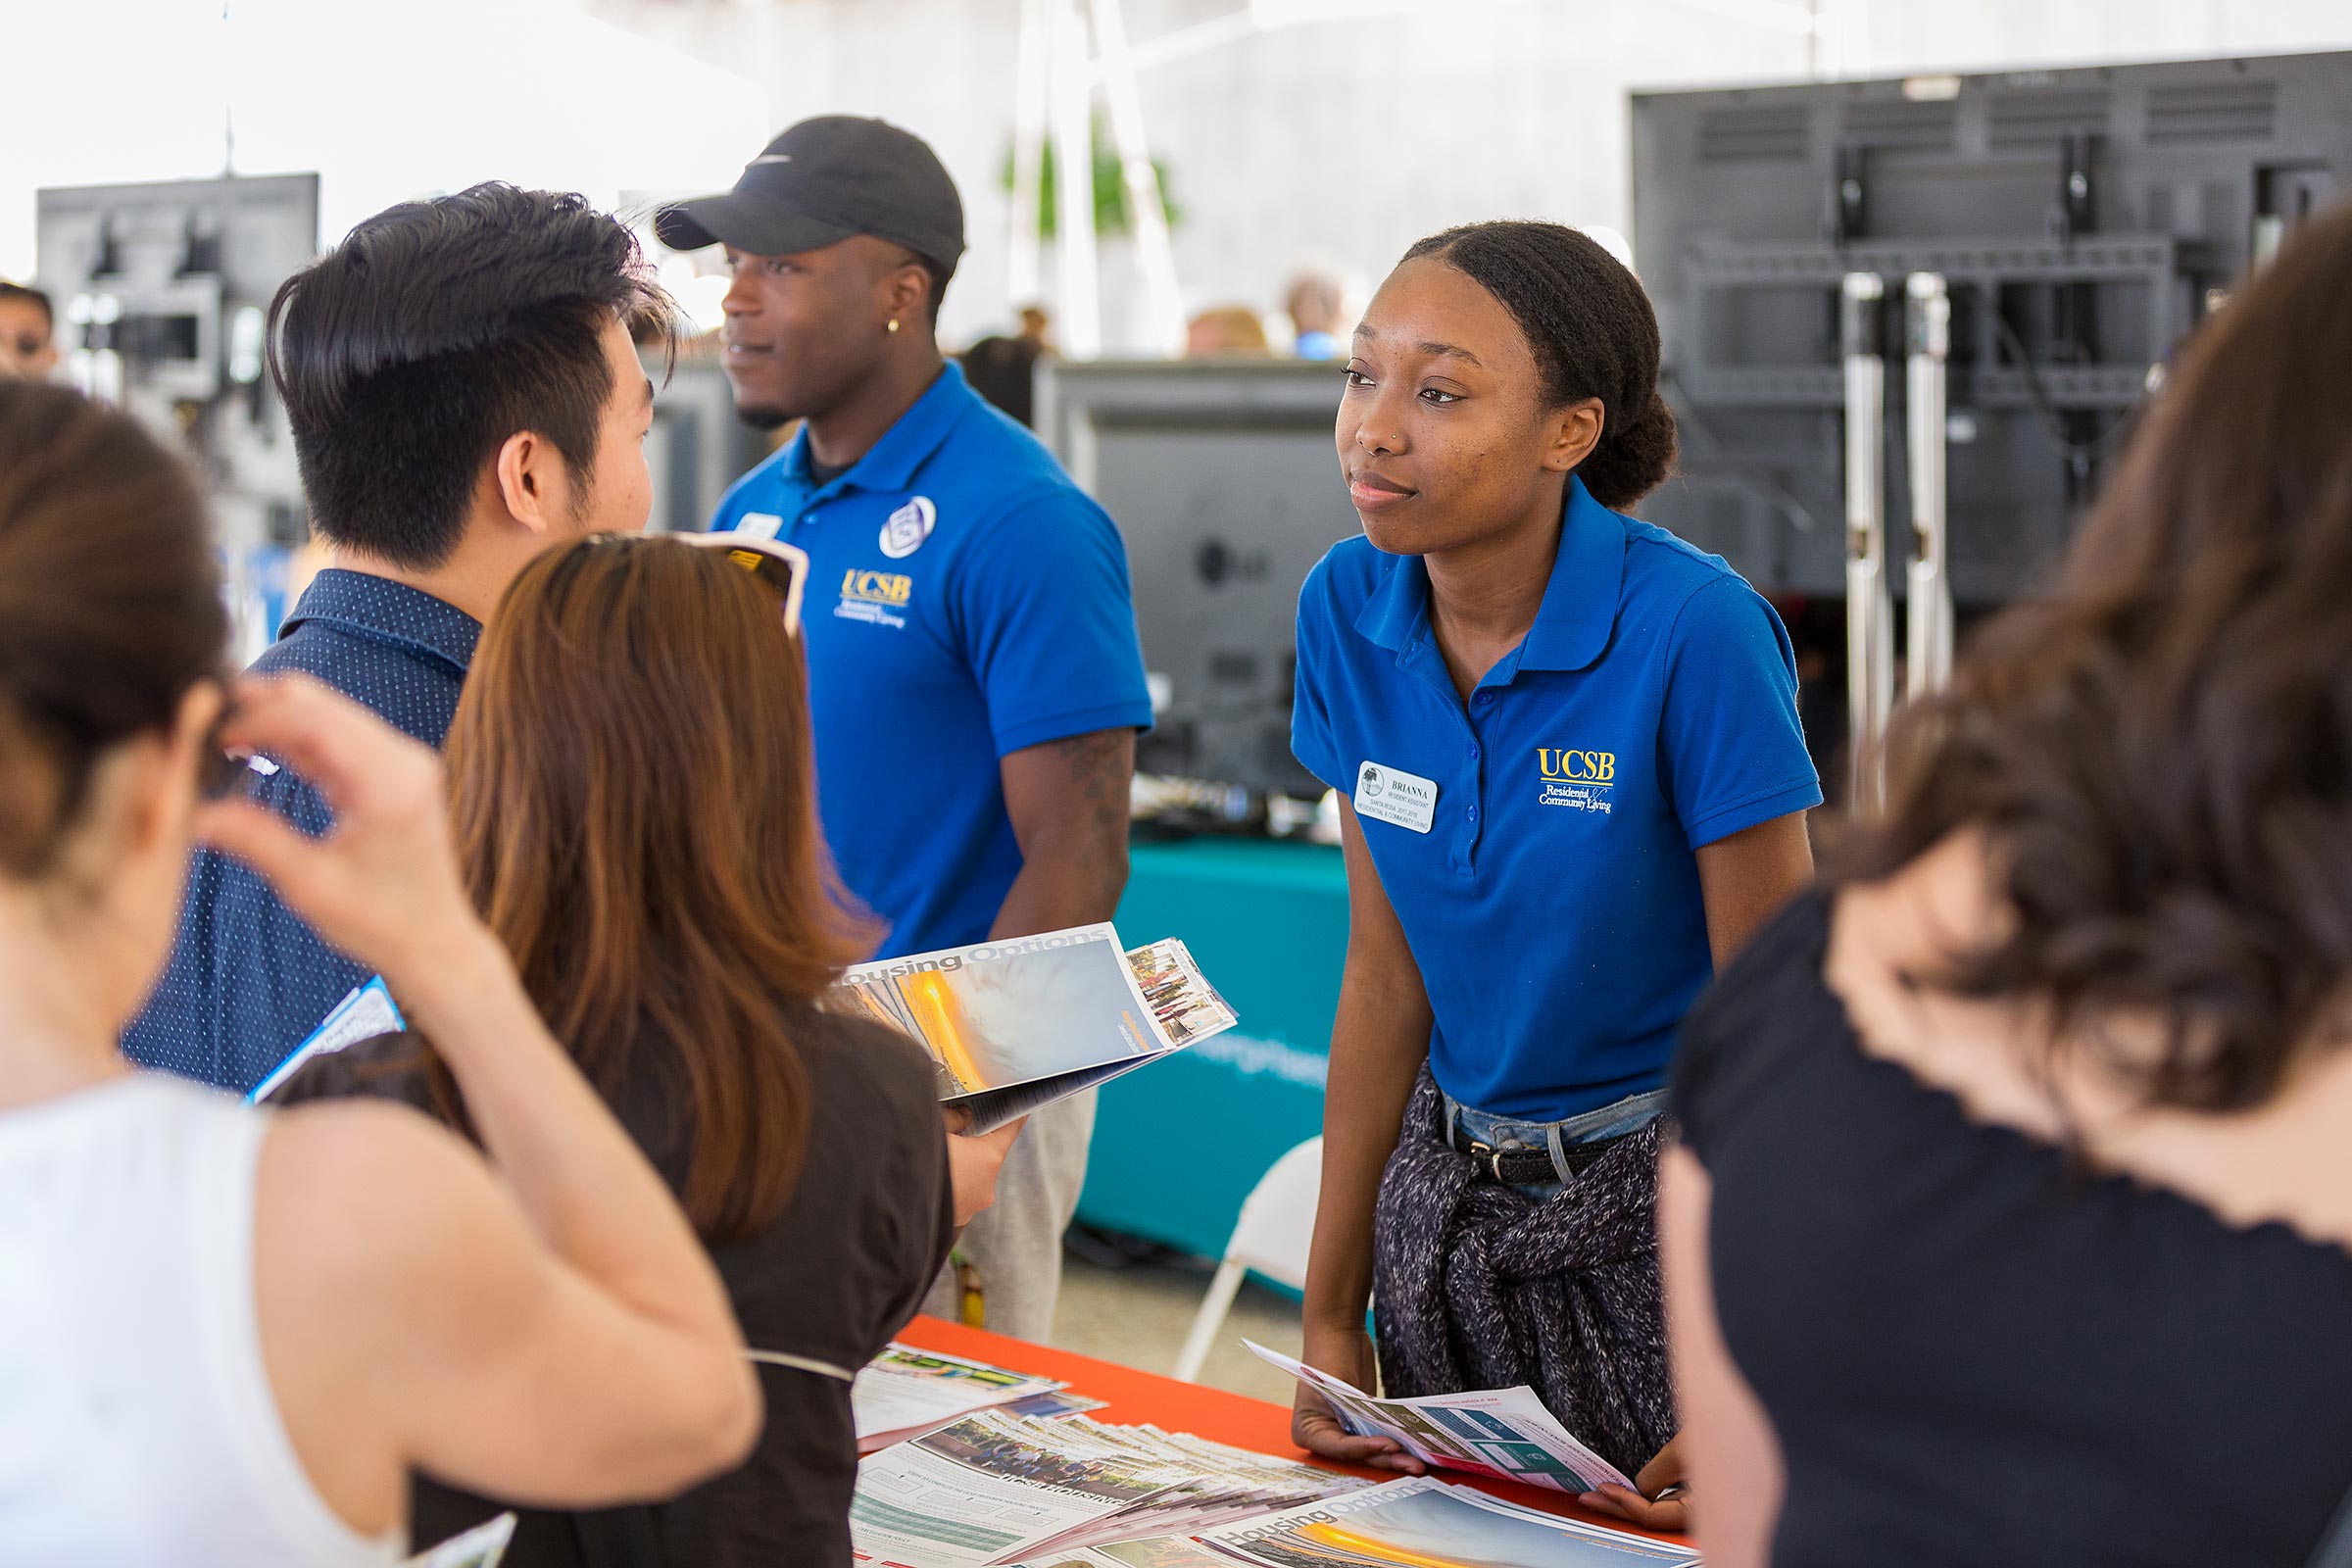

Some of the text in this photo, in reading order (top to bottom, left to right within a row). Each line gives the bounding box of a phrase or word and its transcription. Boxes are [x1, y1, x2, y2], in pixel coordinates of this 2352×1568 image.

[842, 568, 912, 601] UCSB
[1537, 748, 1615, 780] UCSB
[1392, 780, 1428, 800] BRIANNA
[1539, 794, 1611, 813] Community Living
[1546, 784, 1589, 800] Residential
[839, 928, 1108, 987] ousing Options
[1002, 1472, 1047, 1490] UCSB
[1047, 1483, 1126, 1507] HOUSING
[1214, 1482, 1432, 1546] Housing Options
